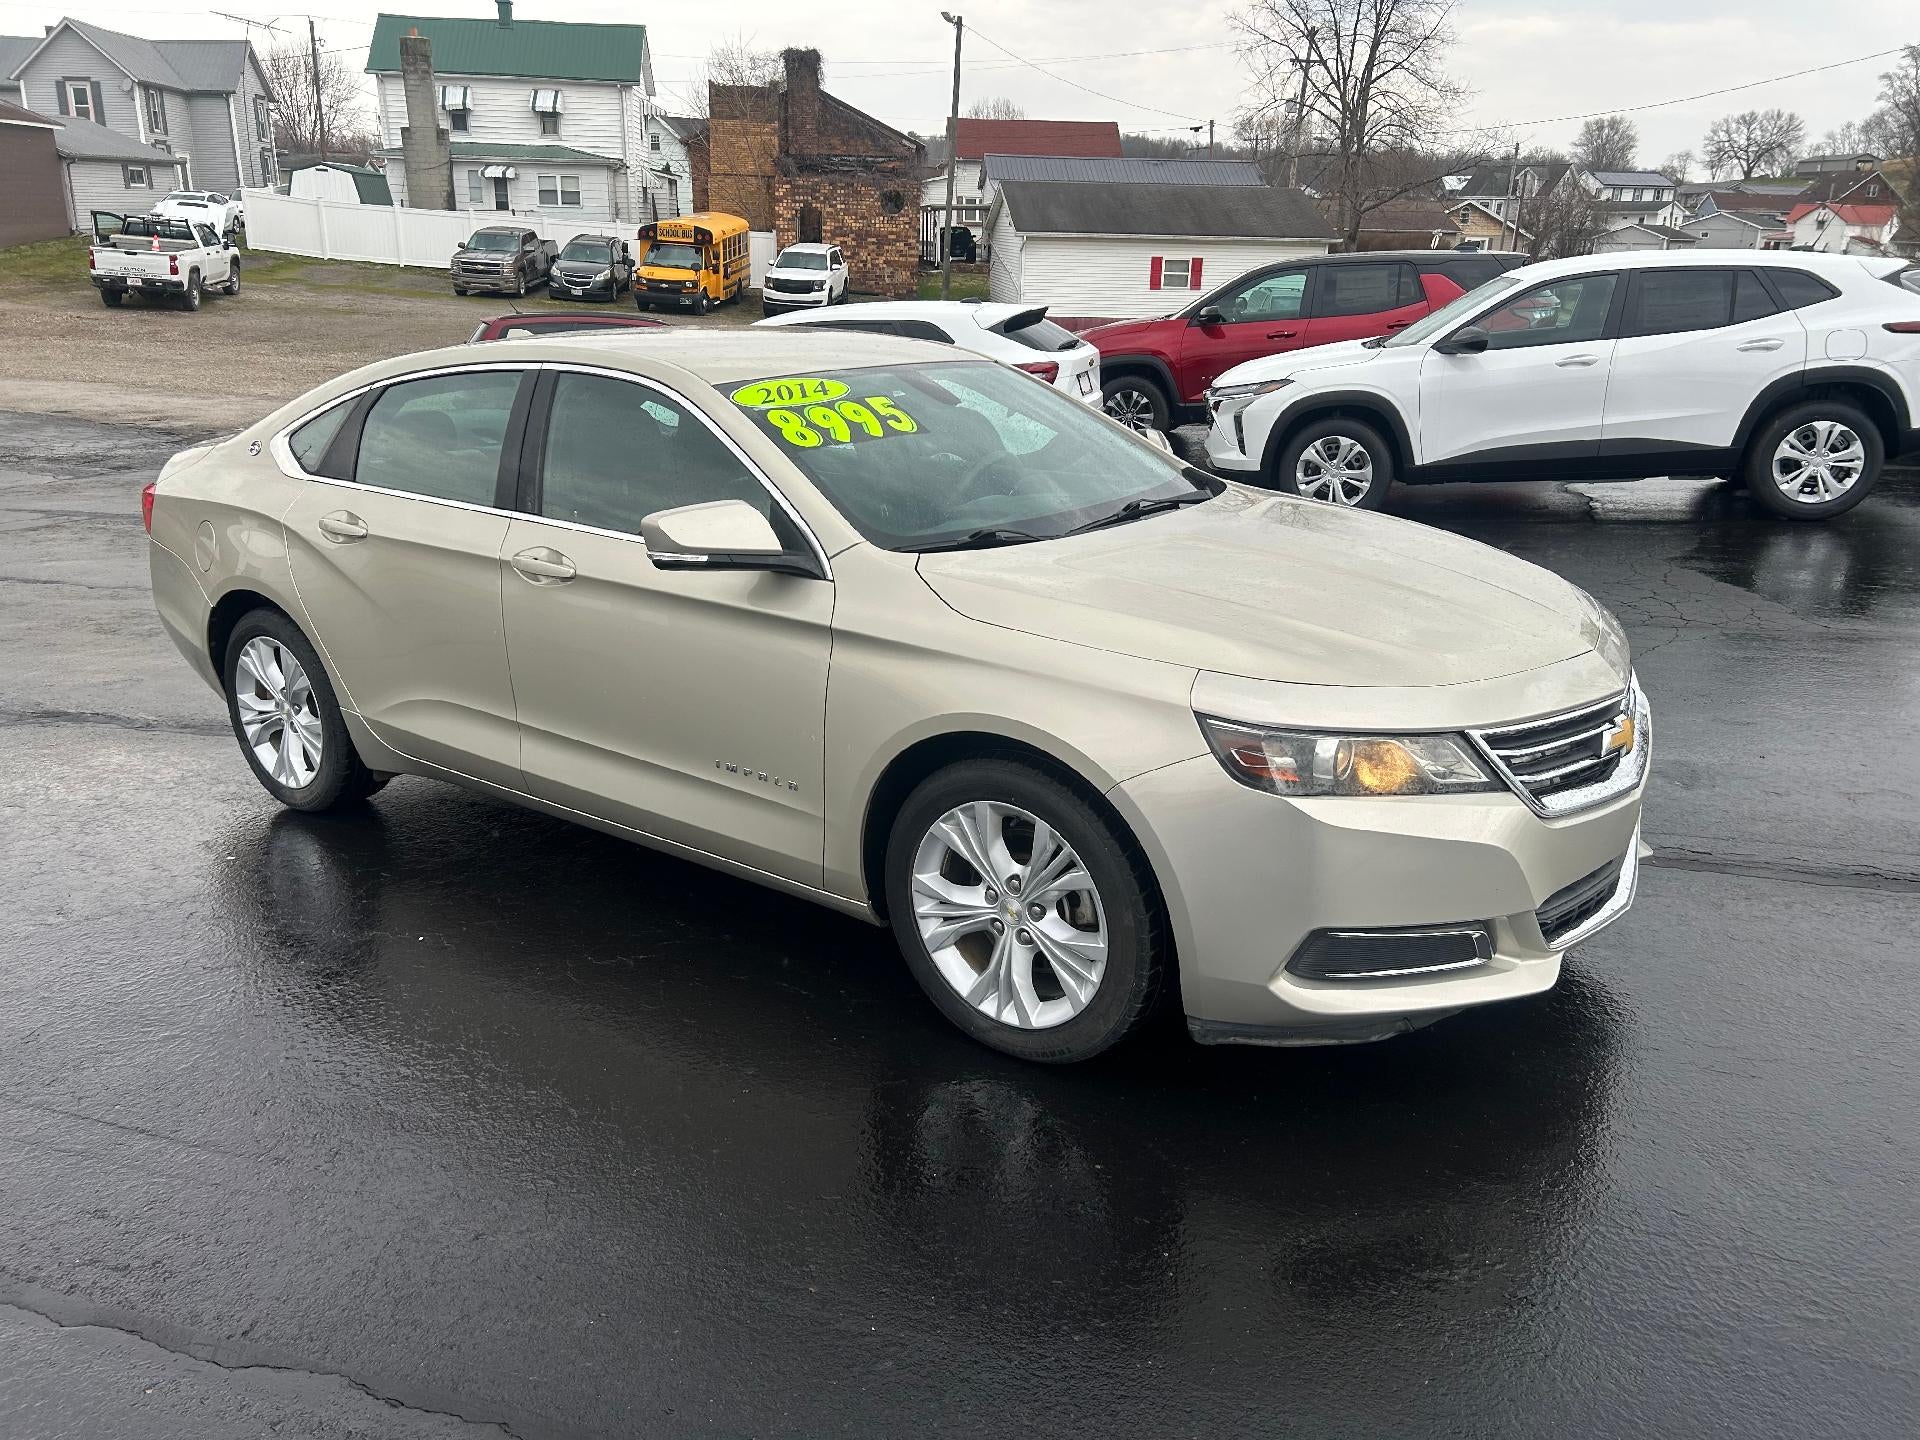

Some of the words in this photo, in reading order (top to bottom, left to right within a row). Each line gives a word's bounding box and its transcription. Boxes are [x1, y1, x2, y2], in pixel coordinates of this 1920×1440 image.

[659, 228, 680, 238] SCHOOL
[681, 229, 693, 239] BUS
[756, 380, 830, 405] 2014
[767, 396, 918, 447] 8995
[715, 759, 798, 792] IMPALA
